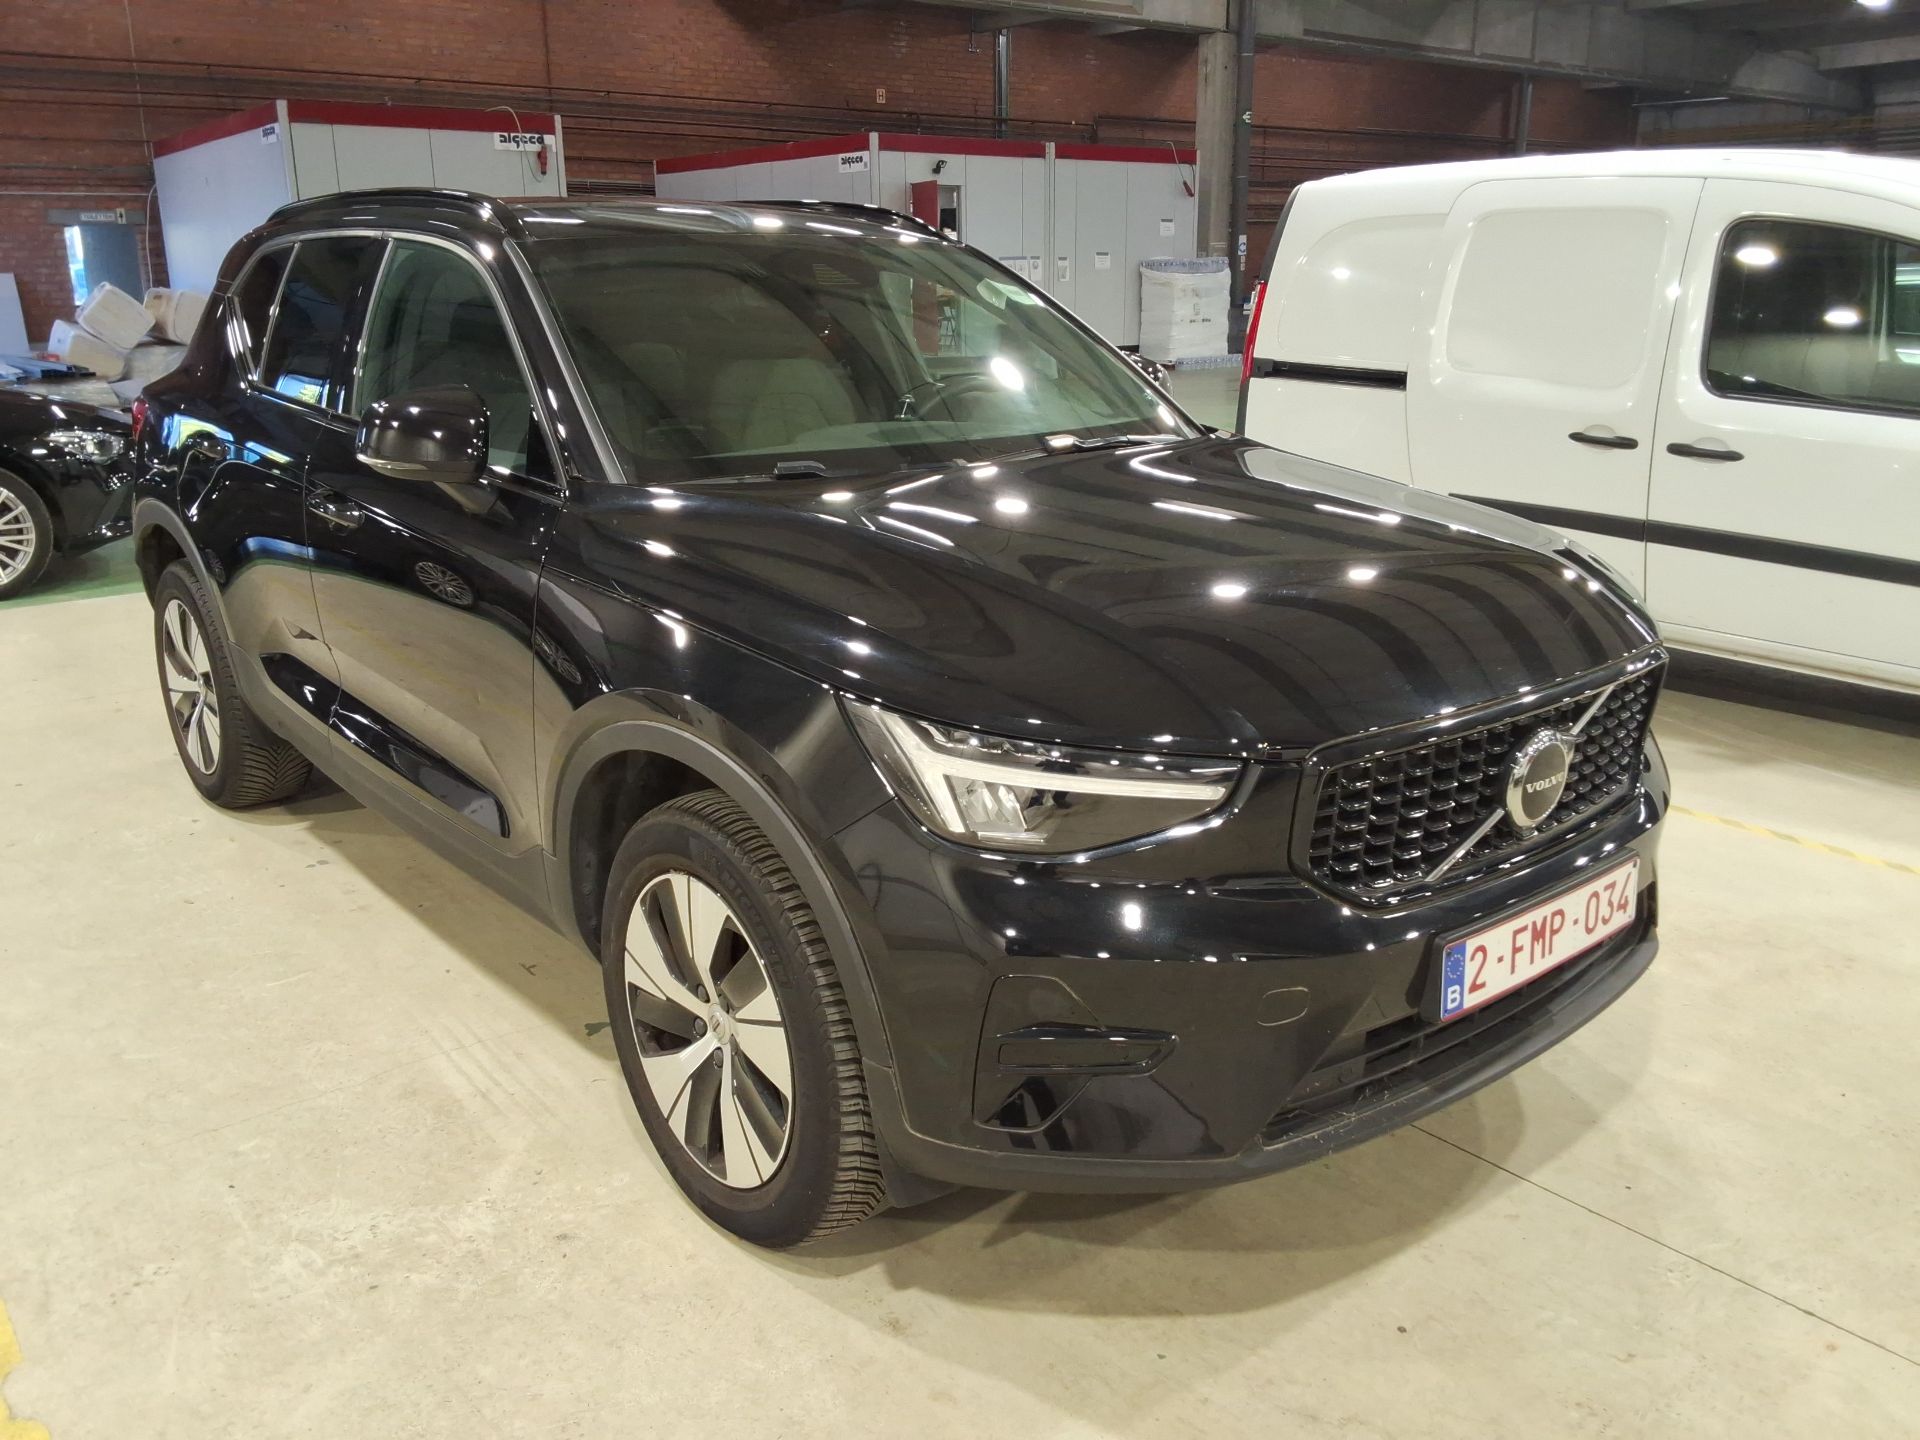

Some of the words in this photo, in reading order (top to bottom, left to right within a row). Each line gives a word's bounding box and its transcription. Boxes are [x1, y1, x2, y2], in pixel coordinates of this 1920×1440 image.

[1526, 772, 1565, 793] VOLVO
[1468, 872, 1631, 994] 2-FMP-034
[1447, 985, 1461, 1010] B
